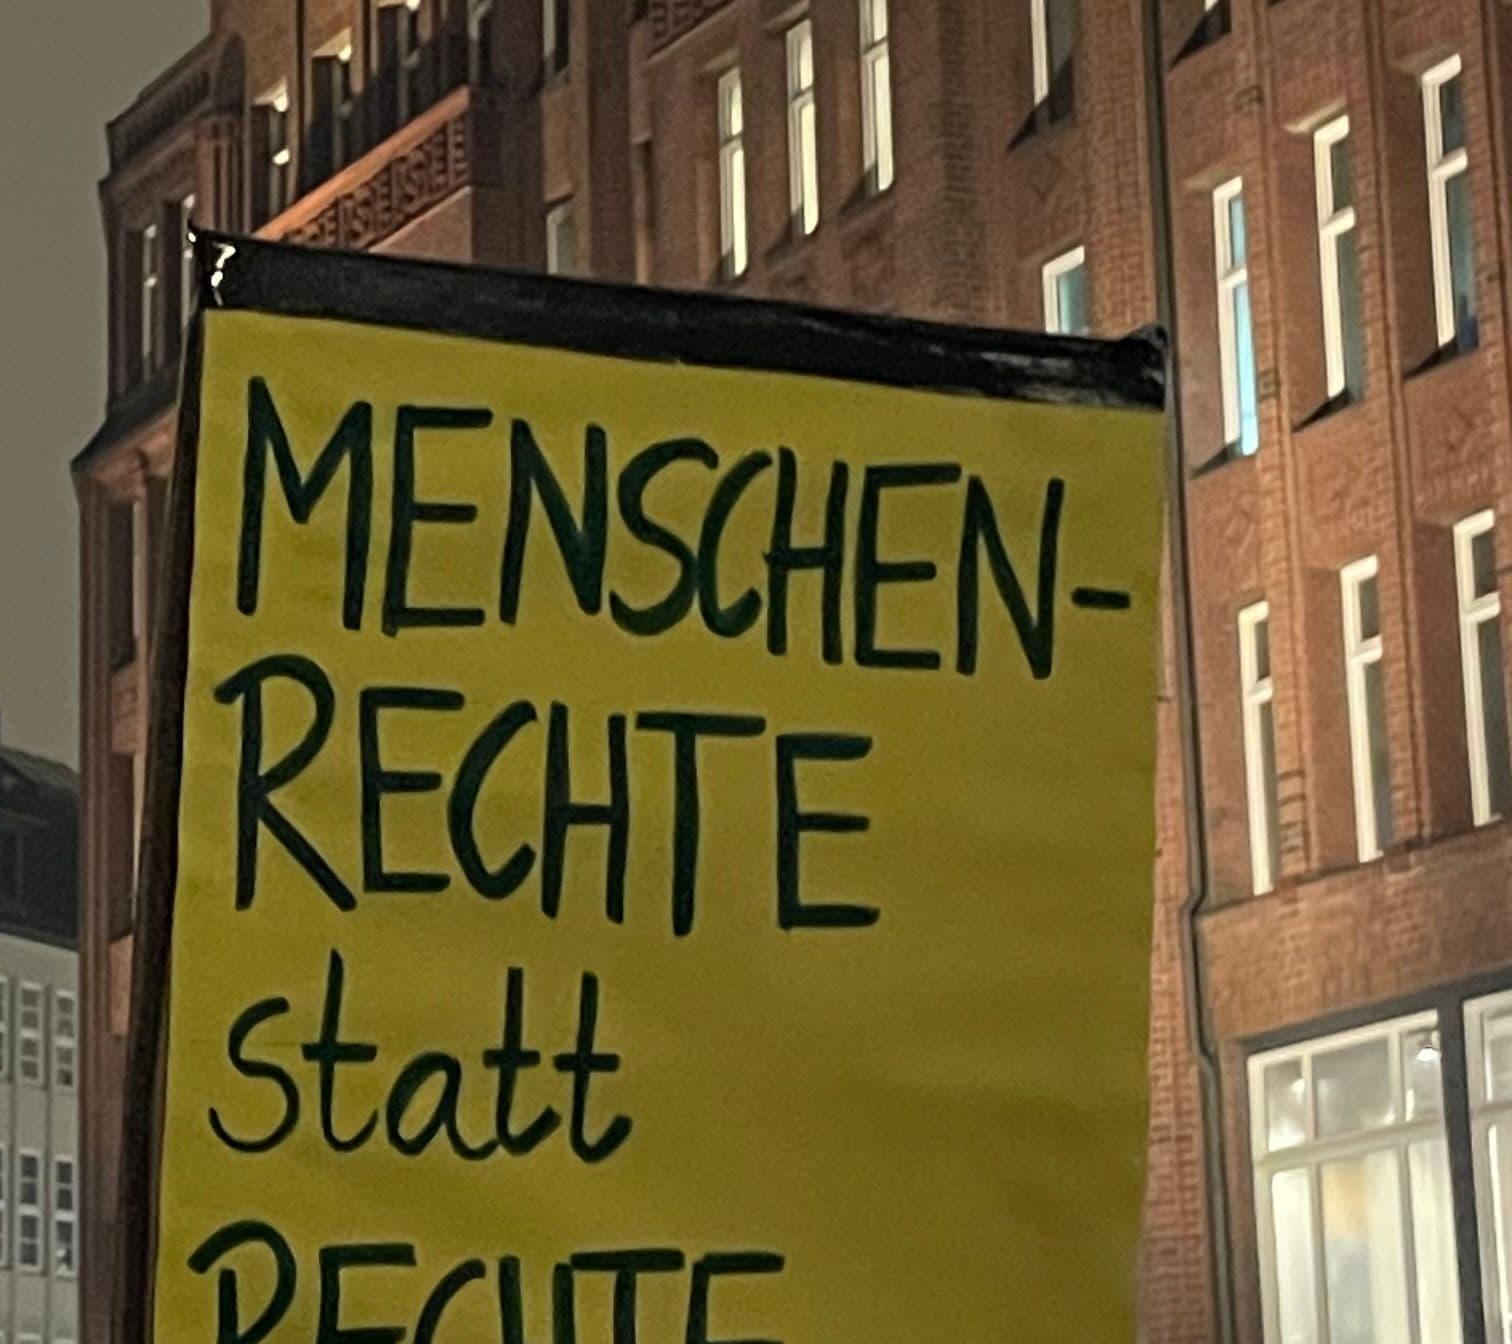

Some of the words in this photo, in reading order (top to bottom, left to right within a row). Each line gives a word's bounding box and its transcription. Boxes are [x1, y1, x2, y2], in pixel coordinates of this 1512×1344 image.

[234, 374, 1133, 681] MENSCHEN-
[211, 652, 883, 939] RECHTE
[207, 947, 635, 1165] statt
